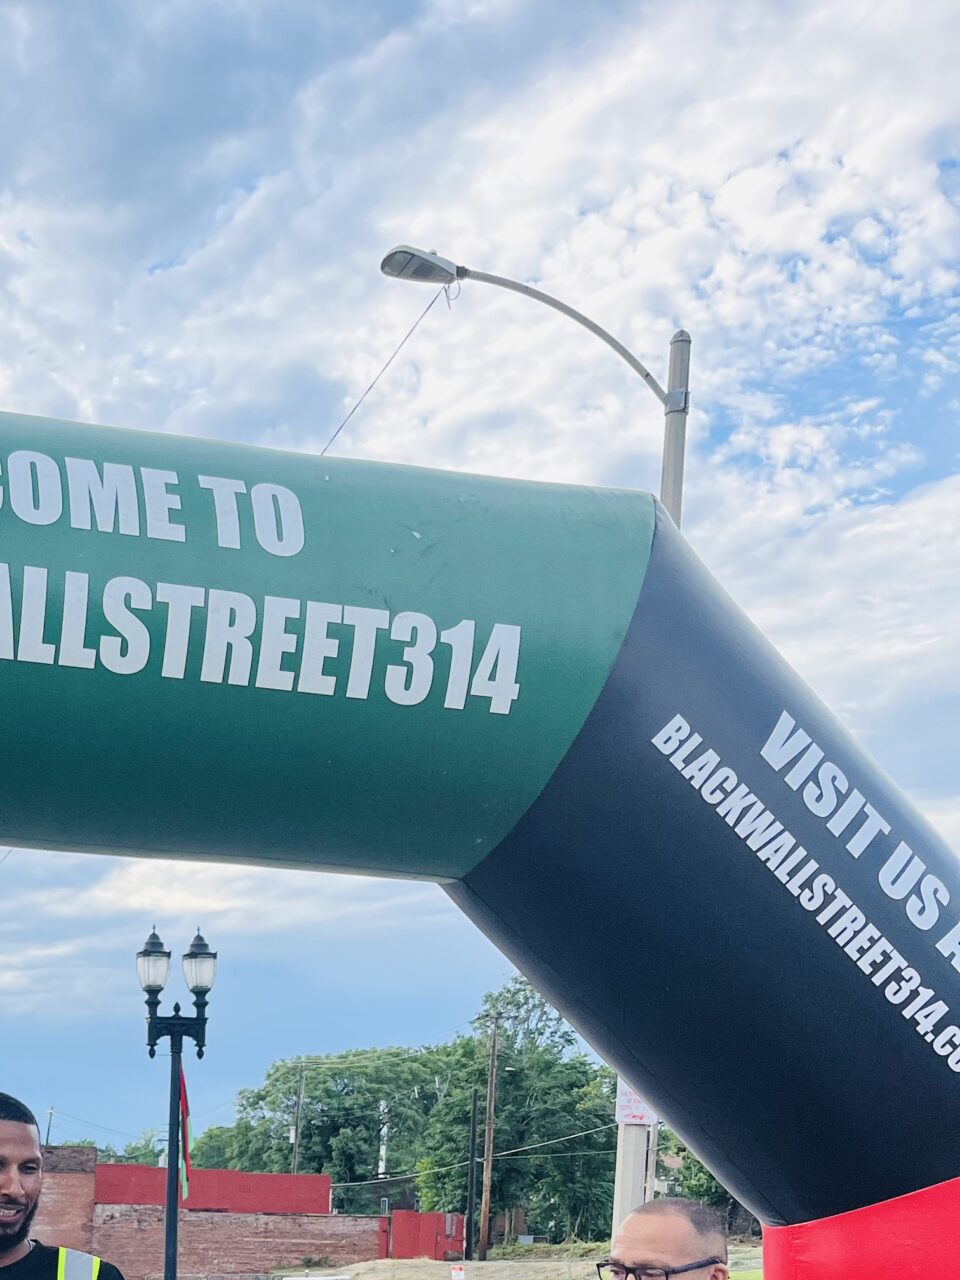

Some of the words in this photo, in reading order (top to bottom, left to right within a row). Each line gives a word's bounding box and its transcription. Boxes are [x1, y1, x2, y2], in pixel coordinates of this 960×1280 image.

[198, 474, 305, 557] TO
[759, 709, 892, 859] VISIT
[878, 841, 950, 931] US
